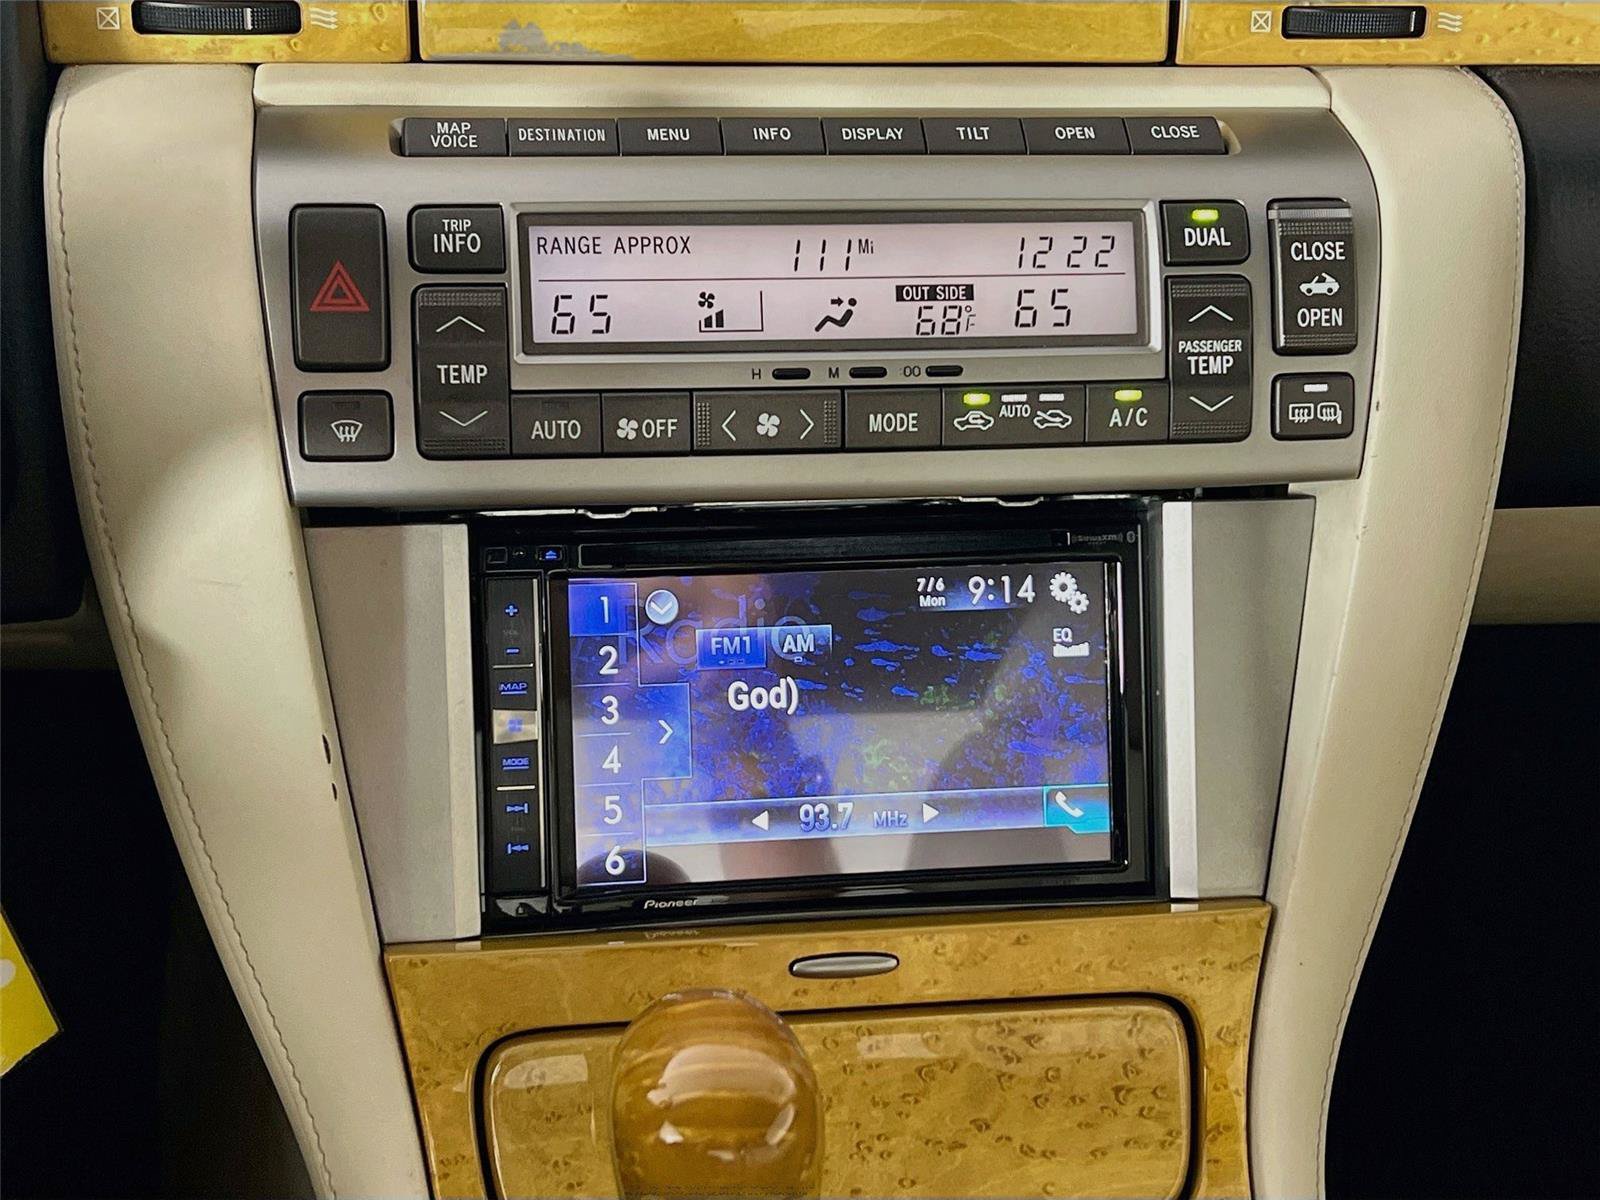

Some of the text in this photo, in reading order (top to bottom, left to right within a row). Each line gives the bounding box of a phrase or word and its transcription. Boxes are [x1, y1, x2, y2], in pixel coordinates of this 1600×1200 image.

[437, 122, 471, 134] MAP
[518, 128, 606, 143] DESTINATION
[646, 128, 691, 142] MENU
[752, 127, 792, 141] INFO
[841, 127, 904, 141] DISPLAY
[956, 126, 991, 141] TILT
[1054, 126, 1095, 140] OPEN
[1150, 125, 1200, 139] CLOSE
[430, 134, 478, 149] VOICE
[442, 219, 471, 232] TRIP
[433, 233, 481, 253] INFO
[536, 236, 602, 255] RANGE
[614, 236, 692, 255] APPROX
[857, 239, 875, 254] Mi
[1184, 228, 1232, 247] DUAL
[1290, 242, 1346, 261] CLOSE
[902, 286, 967, 300] OUT SIDE
[551, 294, 611, 335] 65
[1014, 288, 1072, 328] 65
[1297, 308, 1343, 328] OPEN
[1178, 340, 1243, 354] PASSENGER
[437, 364, 489, 385] TEMP
[751, 368, 762, 380] H
[828, 367, 840, 379] M
[1187, 355, 1235, 375] TEMP
[999, 405, 1031, 419] AUTO
[1108, 408, 1149, 428] A/C
[531, 420, 581, 440] AUTO
[641, 418, 678, 438] OFF
[868, 413, 919, 433] MODE
[916, 575, 1036, 605] 7/6 9:14
[600, 596, 610, 624] 1
[919, 595, 946, 607] Mon
[782, 634, 815, 653] AM
[1053, 628, 1073, 643] EQ
[711, 636, 751, 655] FM1
[598, 646, 619, 675] 2
[500, 682, 528, 691] MAP
[727, 676, 799, 716] God)
[601, 695, 619, 725] 3
[503, 758, 529, 766] MODE
[602, 745, 622, 774] 4
[603, 796, 622, 825] 5
[800, 803, 908, 832] 93.7 MHz
[605, 845, 626, 876] 6
[644, 899, 699, 909] Pioneer
